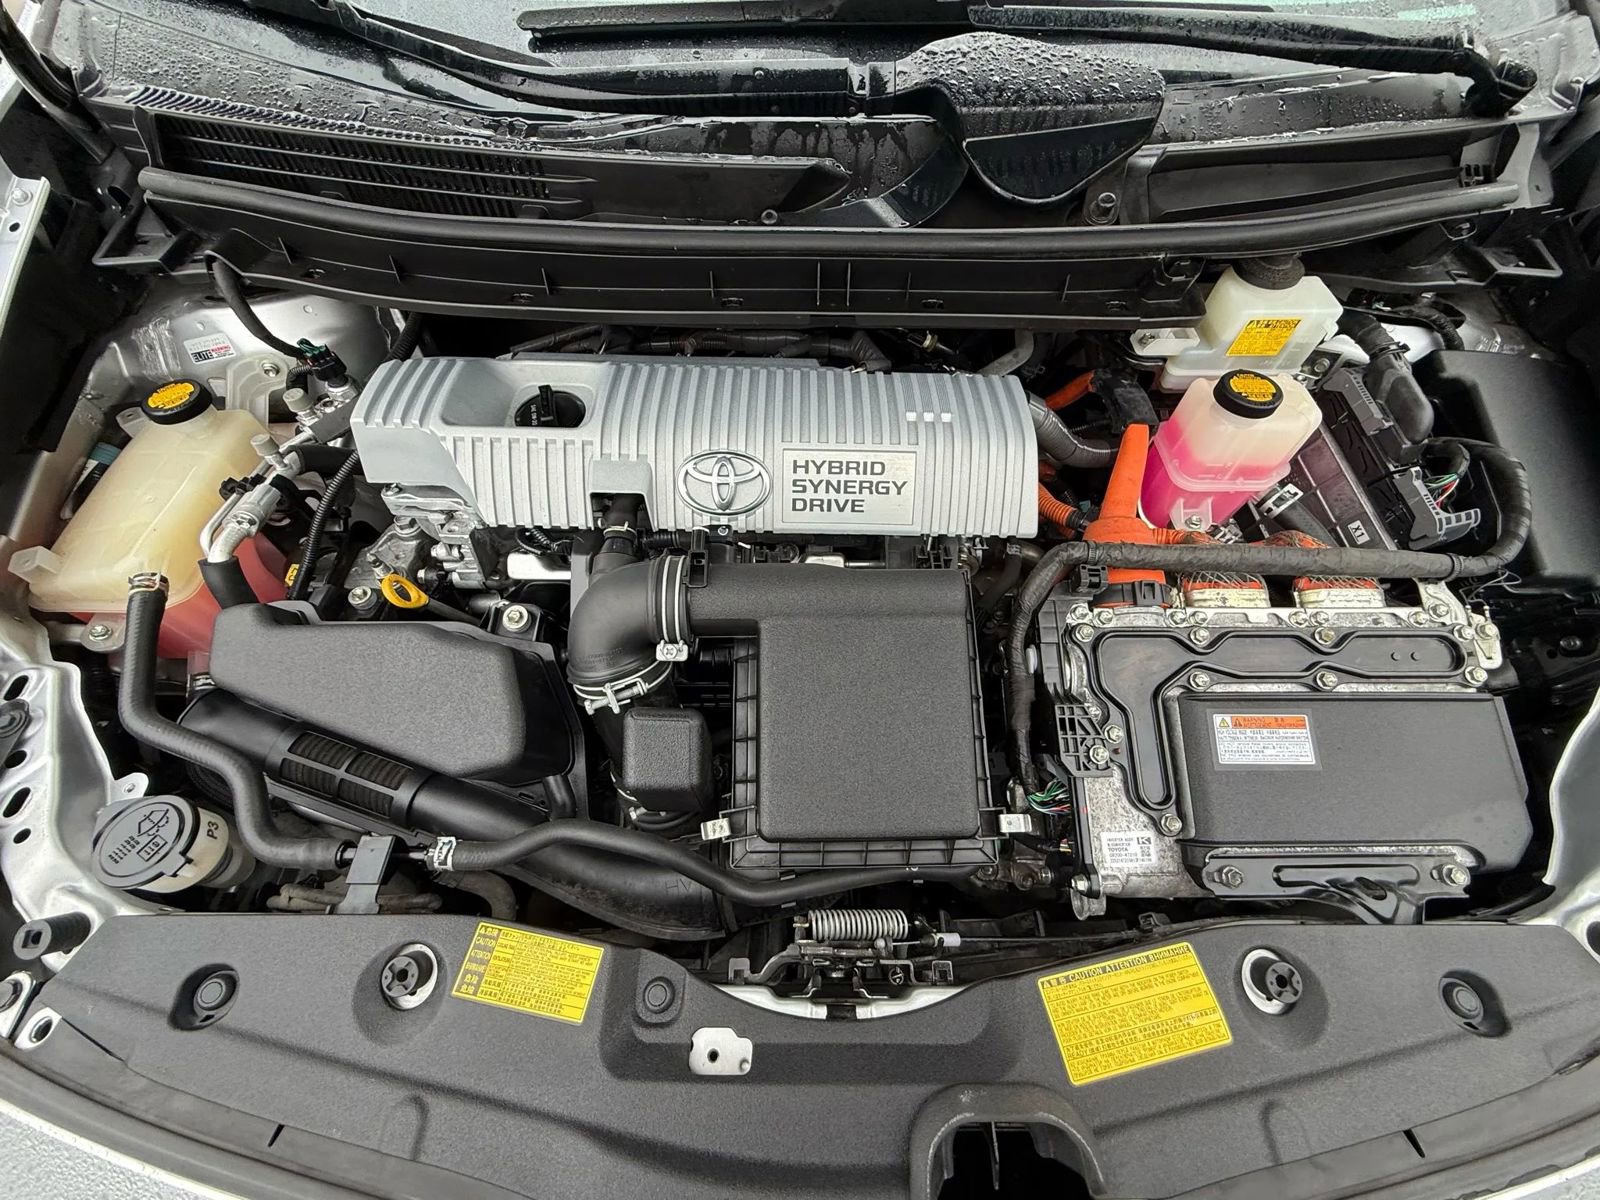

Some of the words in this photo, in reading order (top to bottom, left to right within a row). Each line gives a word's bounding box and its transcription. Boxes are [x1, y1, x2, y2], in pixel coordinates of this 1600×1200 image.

[192, 351, 212, 362] ELITE
[792, 459, 886, 476] HYBRID
[791, 478, 908, 496] SYNERGY
[791, 498, 865, 513] DRIVE
[1352, 524, 1365, 538] X1
[206, 820, 219, 840] P3
[476, 937, 496, 948] CAUTION
[1069, 968, 1103, 983] CAUTION
[1105, 956, 1147, 973] ATTENTION
[1149, 945, 1190, 963] ВНИМАНИЕ
